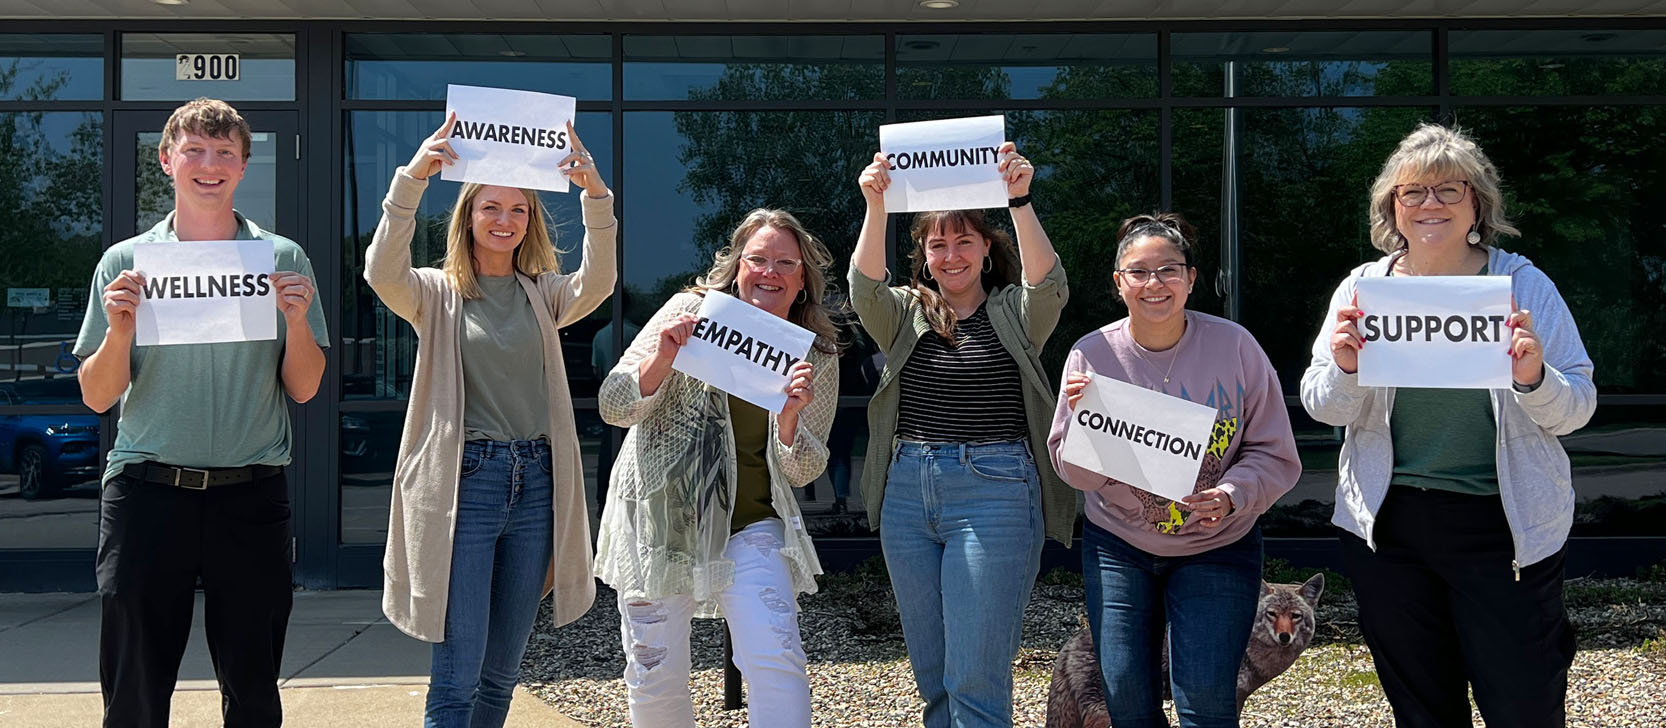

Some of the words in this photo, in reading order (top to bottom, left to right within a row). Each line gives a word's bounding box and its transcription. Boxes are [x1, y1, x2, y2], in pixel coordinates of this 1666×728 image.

[451, 120, 567, 150] AWARENESS
[886, 146, 1000, 171] COMMUNITY
[143, 274, 270, 300] WELLNESS
[1364, 315, 1505, 343] SUPPORT
[692, 317, 801, 377] EMPATHY
[1077, 409, 1202, 461] CONNECTION
